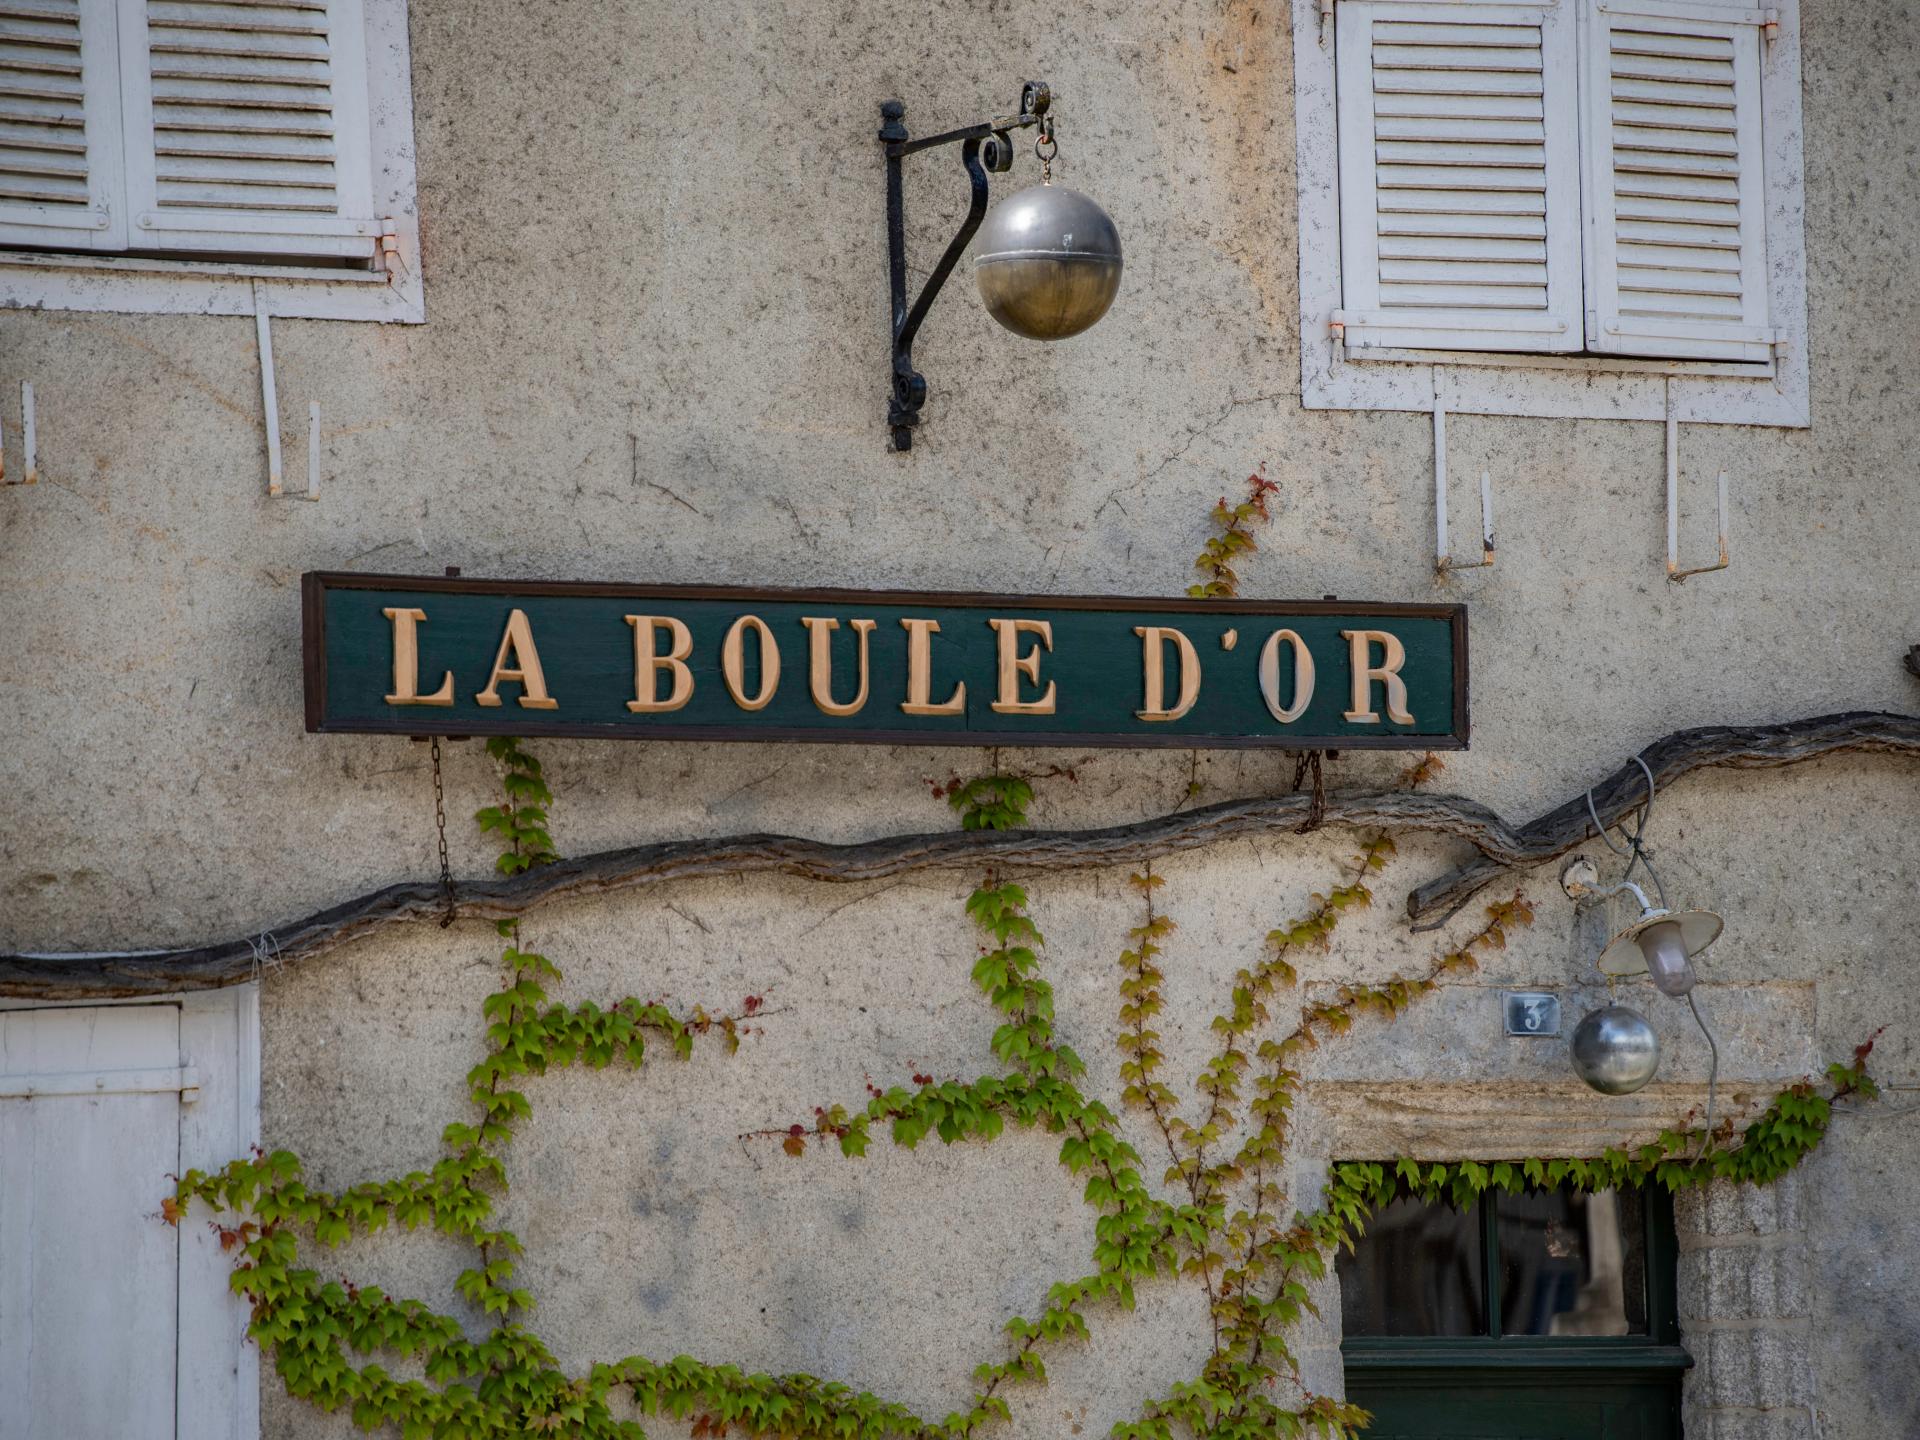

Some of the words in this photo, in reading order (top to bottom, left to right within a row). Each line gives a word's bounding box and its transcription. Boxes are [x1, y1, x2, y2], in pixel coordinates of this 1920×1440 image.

[382, 607, 559, 711] LA
[624, 614, 1056, 717] BOULE
[1133, 626, 1416, 726] D'OR
[1523, 999, 1541, 1031] 3
